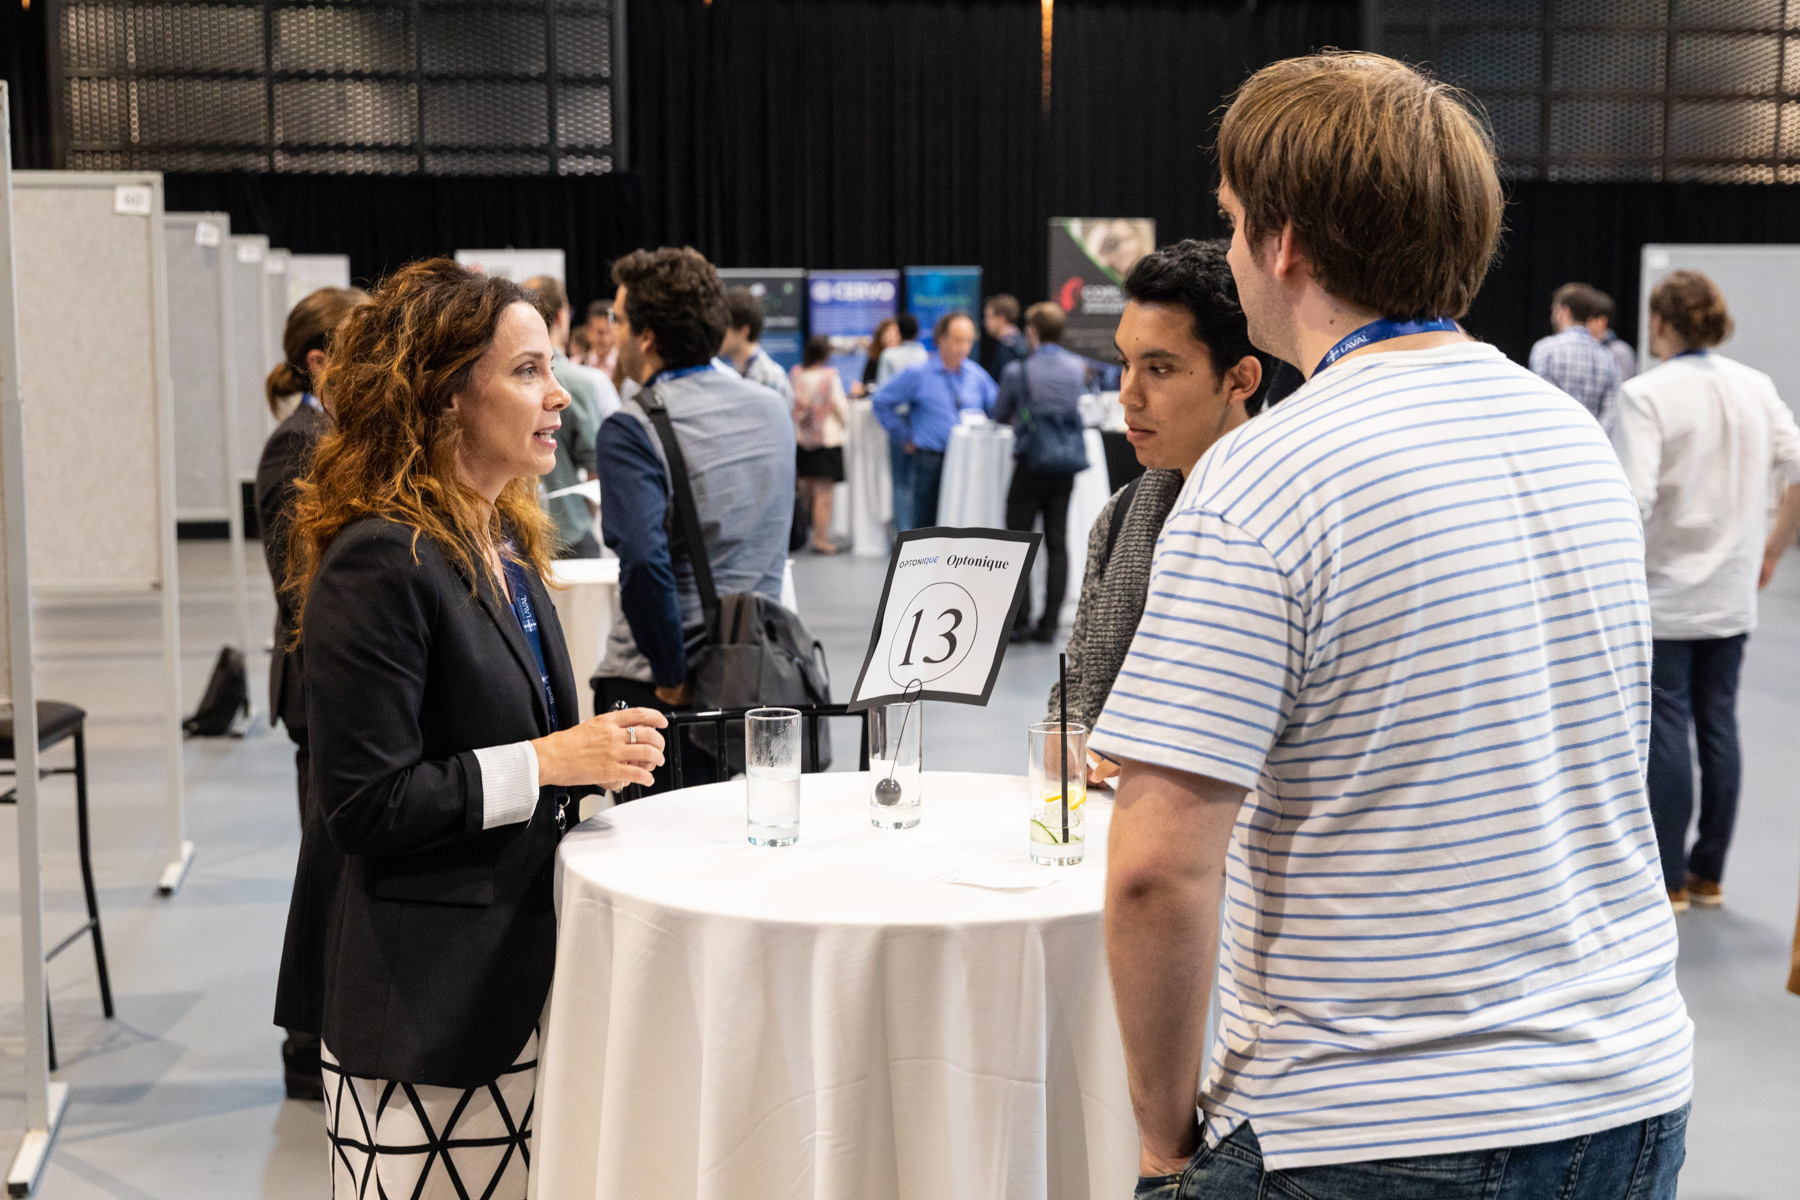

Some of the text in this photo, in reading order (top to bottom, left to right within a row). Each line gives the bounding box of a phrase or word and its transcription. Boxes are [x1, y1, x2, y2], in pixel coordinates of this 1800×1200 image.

[832, 281, 895, 301] CERVO
[1340, 335, 1370, 353] LAVAL
[899, 554, 1009, 571] OPTONIQUE Optonique
[520, 595, 532, 618] LAVAL
[898, 608, 963, 667] 13
[546, 686, 555, 704] Nord
